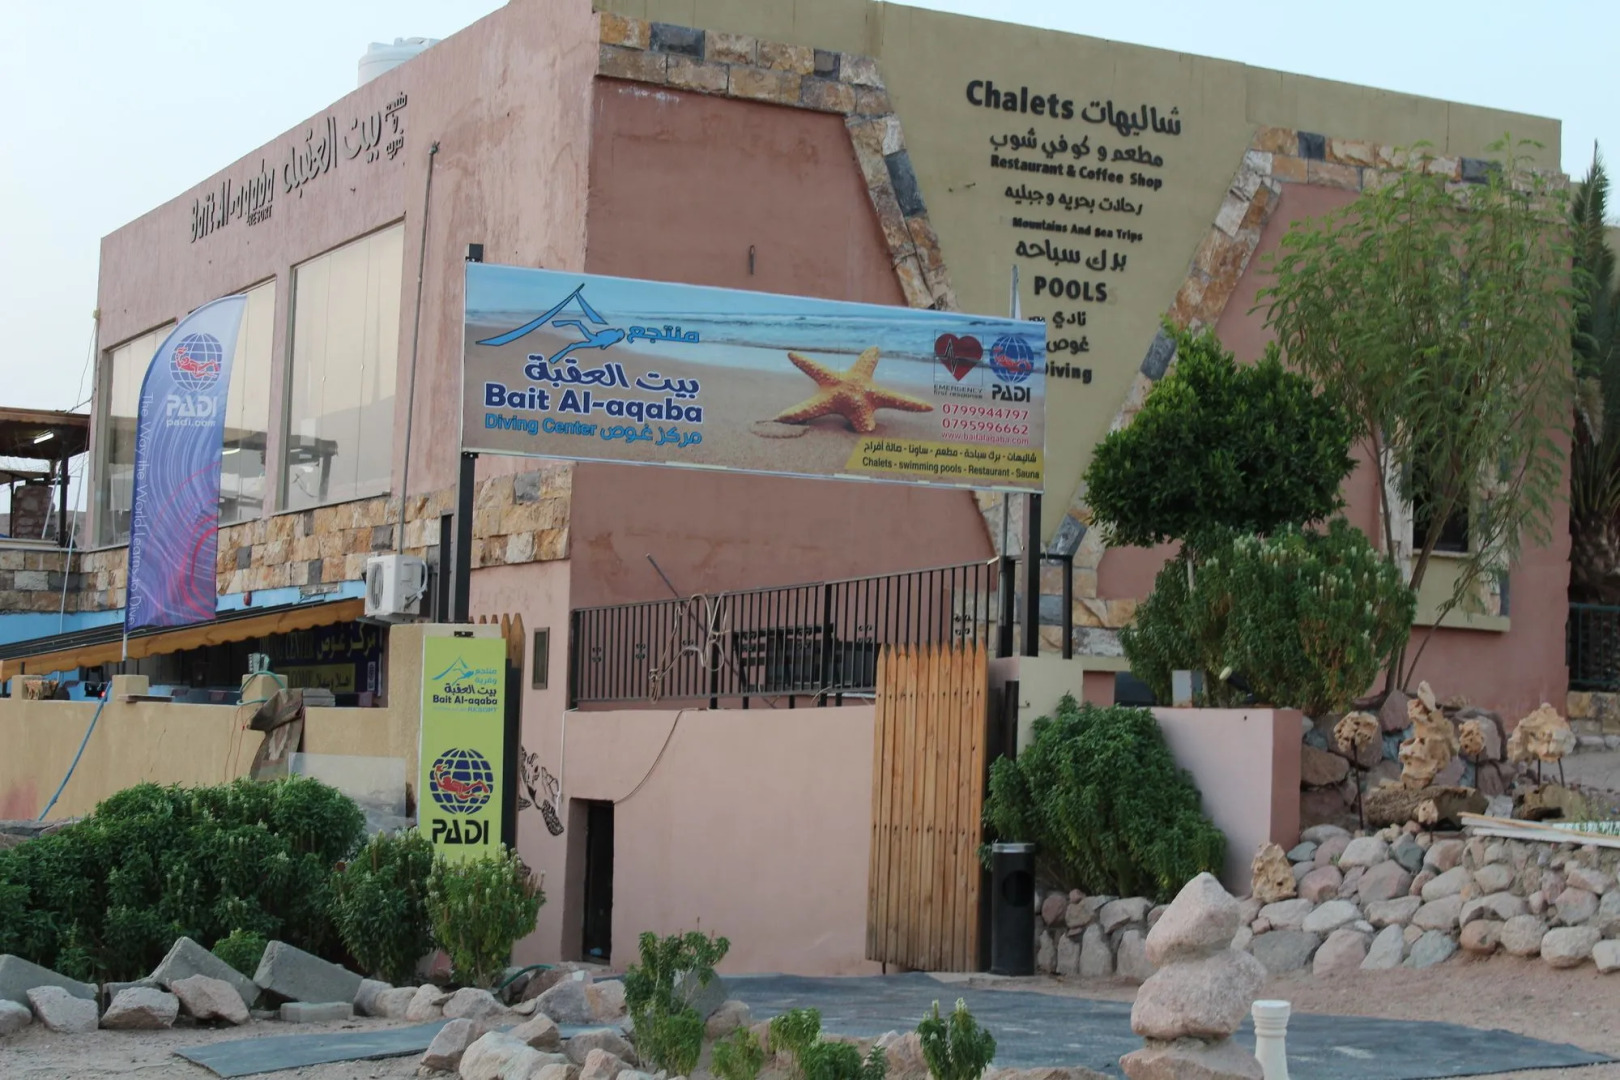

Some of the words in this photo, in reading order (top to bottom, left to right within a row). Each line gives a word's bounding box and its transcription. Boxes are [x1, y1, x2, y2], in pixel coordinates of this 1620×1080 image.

[966, 79, 1074, 119] Chalets
[1081, 100, 1182, 137] شاليهات
[344, 111, 382, 164] بيت
[989, 127, 1038, 150] شوب
[1097, 145, 1107, 162] و
[1111, 144, 1164, 167] مطعم
[990, 154, 1064, 176] Restaurant
[1066, 164, 1076, 178] &
[1078, 165, 1124, 185] Coffee
[1129, 172, 1163, 191] Shop
[1058, 191, 1095, 214] بحريه
[1099, 197, 1143, 216] رحلات
[191, 191, 215, 244] Bait
[248, 204, 273, 227] RESORT
[1012, 217, 1067, 234] Mountains
[1070, 223, 1091, 236] And
[1094, 226, 1113, 239] Sea
[1116, 228, 1143, 243] Trips
[1015, 239, 1080, 267] سباحه
[1034, 276, 1108, 302] POOLS
[1052, 311, 1087, 329] نادي
[626, 324, 700, 344] منتجع
[524, 354, 630, 388] العقبة
[1045, 362, 1093, 384] iving
[635, 373, 700, 399] بيت
[991, 384, 1031, 403] PADI
[141, 392, 154, 417] The
[166, 394, 218, 417] PADI
[484, 383, 551, 412] Bait
[557, 388, 703, 424] Al-aqaba
[942, 403, 1029, 421] 0799944797
[166, 418, 216, 427] padi.com
[485, 413, 539, 435] Diving
[542, 417, 597, 437] Center
[600, 423, 653, 444] غوص
[942, 419, 1029, 435] 0795996662
[136, 422, 151, 456] Way
[655, 426, 702, 448] مركز
[934, 448, 958, 458] مطعم
[1007, 451, 1037, 464] شاليهات
[137, 460, 150, 480] the
[862, 457, 893, 469] Chalets
[899, 461, 939, 474] swimming
[940, 464, 962, 475] pools
[968, 466, 1010, 478] Restaurant
[1015, 468, 1040, 479] Sauna
[133, 485, 148, 527] World
[131, 533, 145, 574] Learns
[130, 578, 141, 592] to
[127, 596, 141, 626] Dive
[433, 694, 452, 704] Bait
[454, 696, 498, 706] Al-aqaba
[444, 683, 476, 695] العقبة
[477, 687, 497, 697] بيت
[432, 819, 489, 845] PADI
